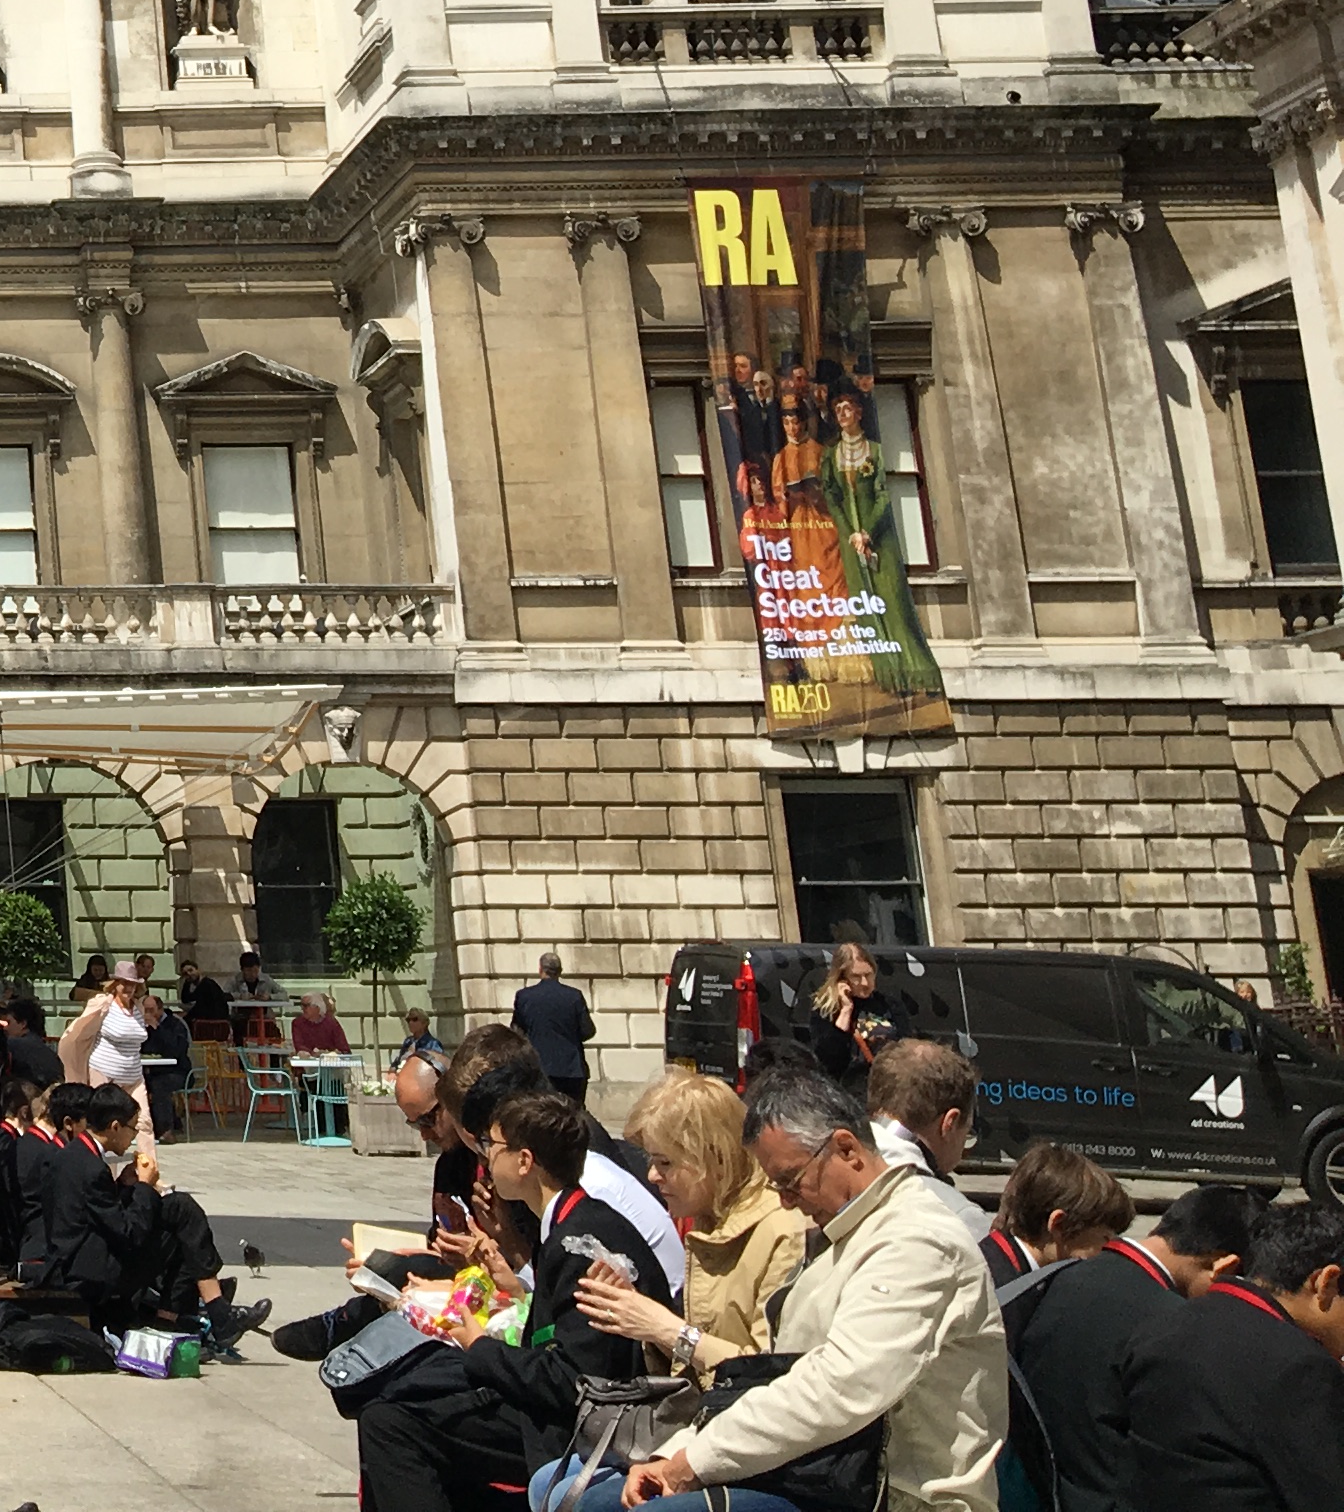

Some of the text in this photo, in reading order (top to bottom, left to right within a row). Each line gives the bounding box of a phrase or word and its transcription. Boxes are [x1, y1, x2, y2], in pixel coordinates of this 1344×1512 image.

[694, 190, 799, 286] RA
[813, 519, 834, 529] Arts
[747, 534, 791, 562] The
[754, 563, 823, 590] Great
[758, 590, 887, 624] Spectacle
[763, 624, 876, 642] 250 Years of the
[765, 639, 902, 660] Summer Exhibition
[770, 683, 831, 714] RA250
[1008, 1079, 1068, 1103] ideas
[1074, 1086, 1097, 1105] to
[1104, 1086, 1135, 1108] life
[1204, 1119, 1245, 1130] creations
